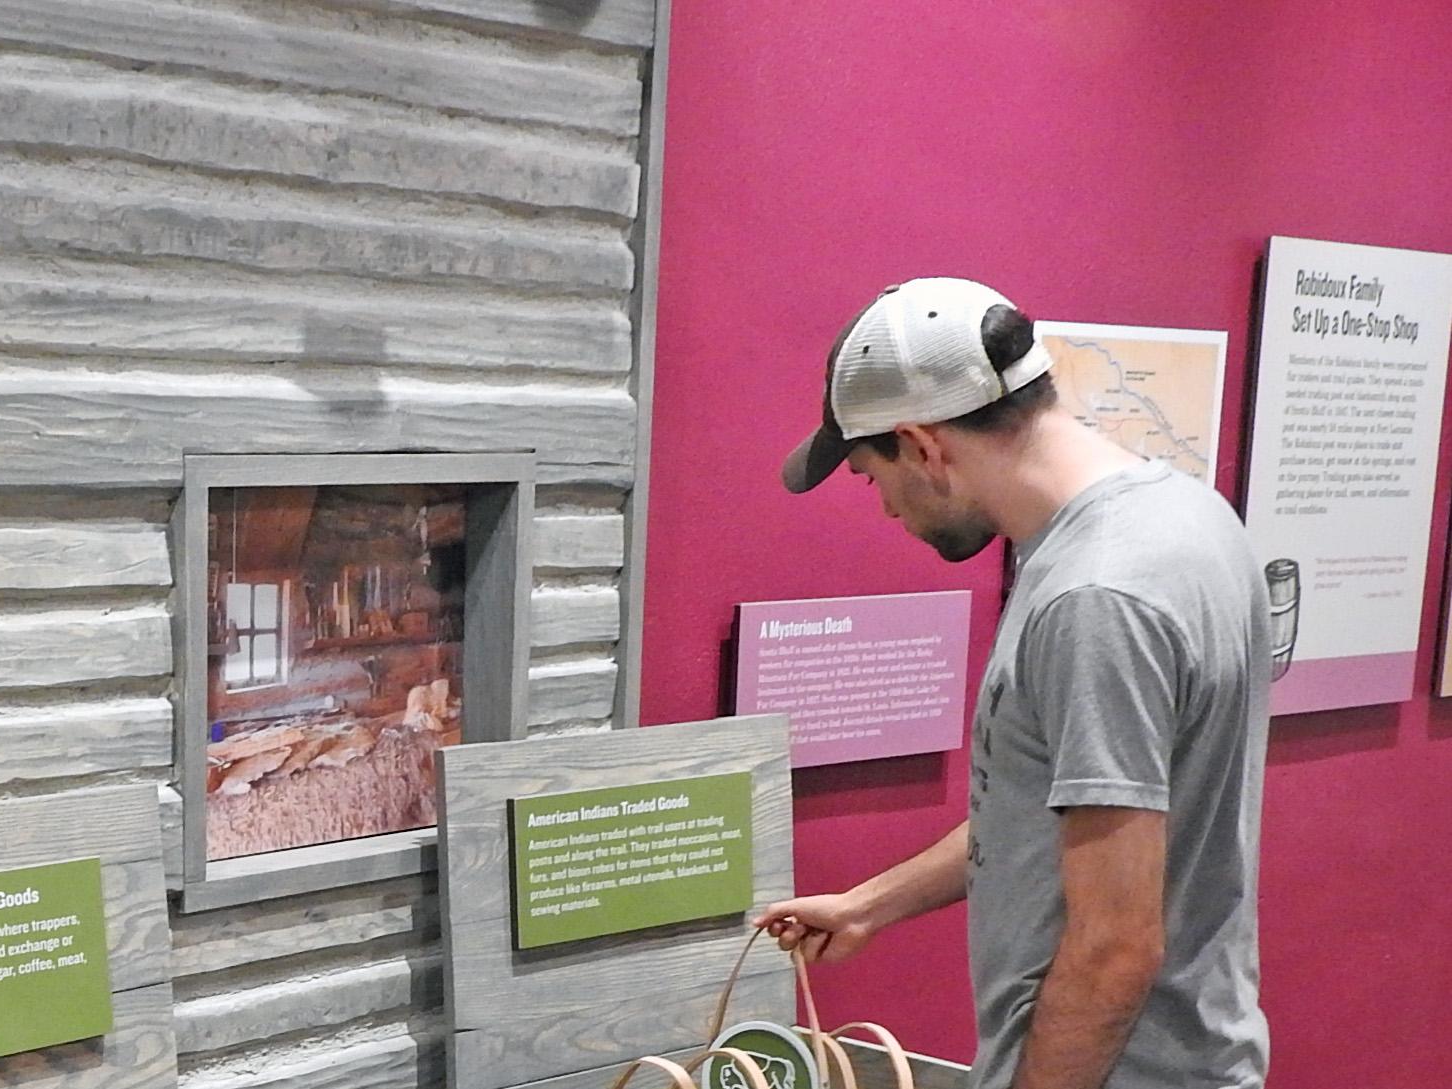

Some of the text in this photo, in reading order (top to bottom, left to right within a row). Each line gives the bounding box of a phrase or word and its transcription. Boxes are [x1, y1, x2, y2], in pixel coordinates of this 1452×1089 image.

[1295, 269, 1385, 307] Robidoux Family
[1292, 306, 1419, 344] Set Up a One-Stop Shop
[759, 616, 852, 640] A Mysterious Death
[527, 793, 690, 828] American Indians Traded Goods
[31, 914, 80, 932] trappers,
[7, 938, 60, 956] exchange
[61, 935, 73, 946] or
[18, 958, 56, 974] coffee,
[57, 952, 87, 967] meat,
